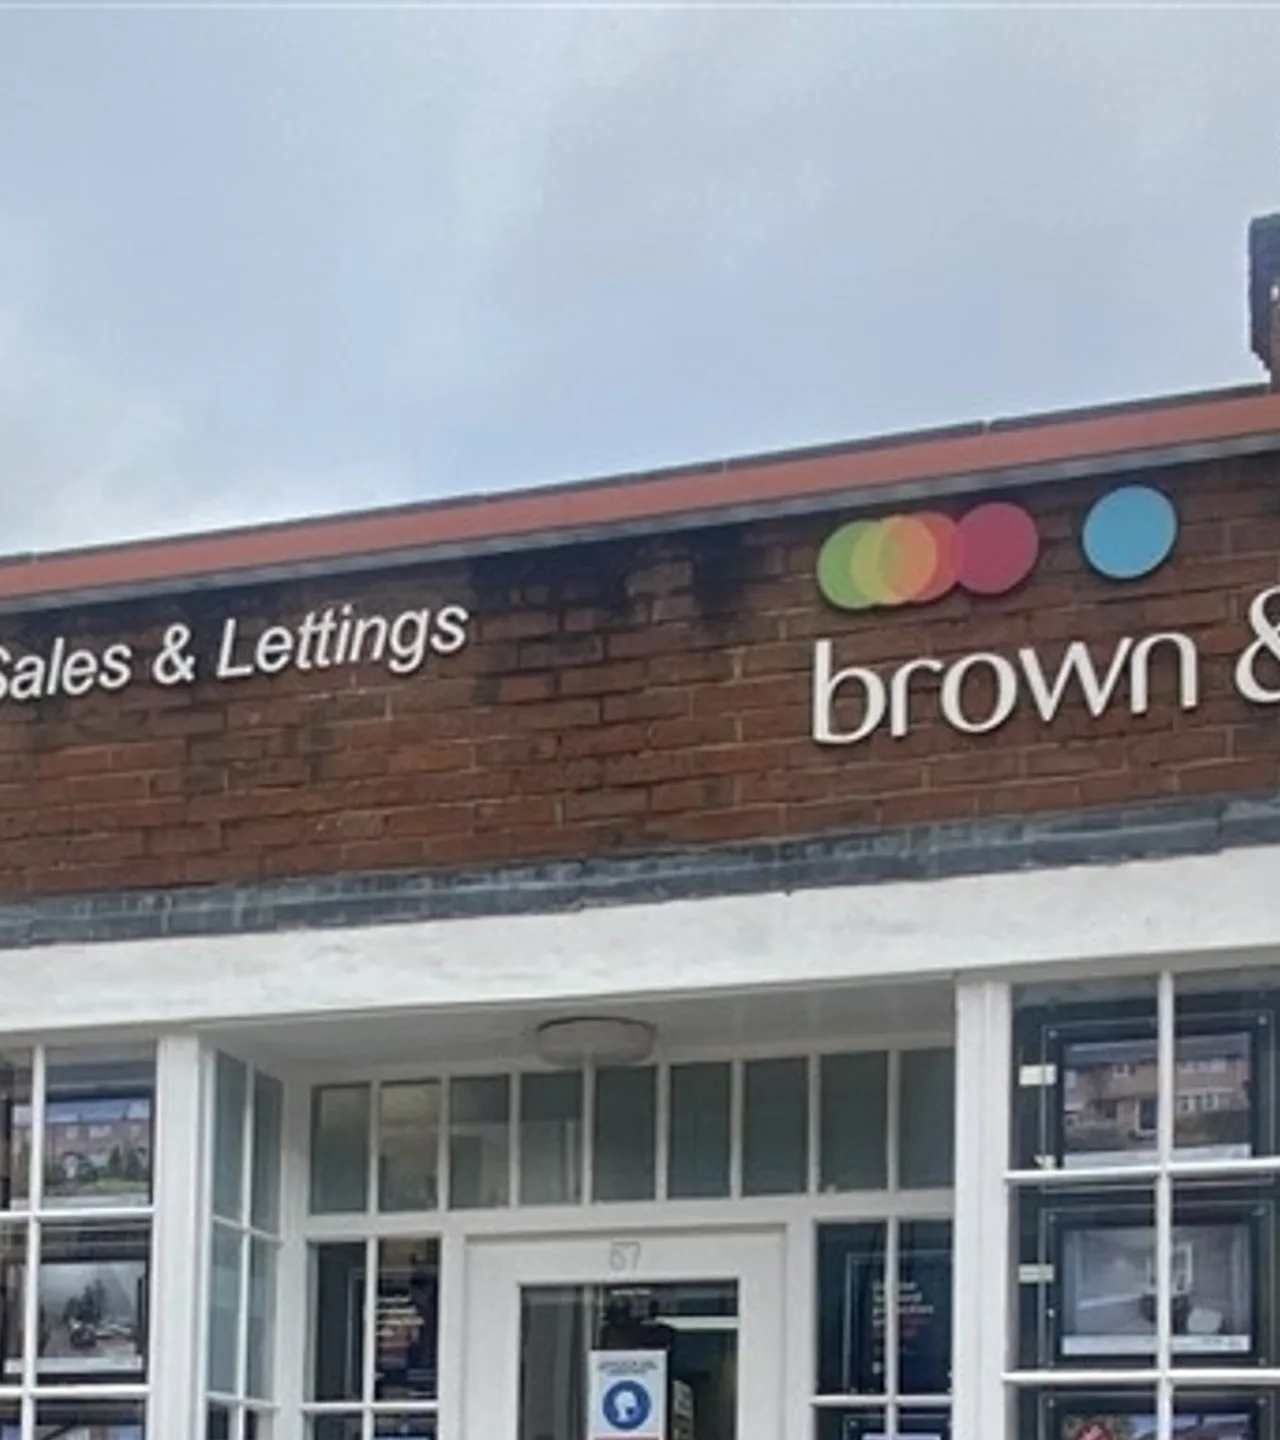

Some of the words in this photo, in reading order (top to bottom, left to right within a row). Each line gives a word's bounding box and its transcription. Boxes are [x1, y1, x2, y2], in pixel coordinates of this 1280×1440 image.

[152, 622, 197, 686] &
[216, 597, 471, 680] Lettings
[811, 630, 1198, 747] brown
